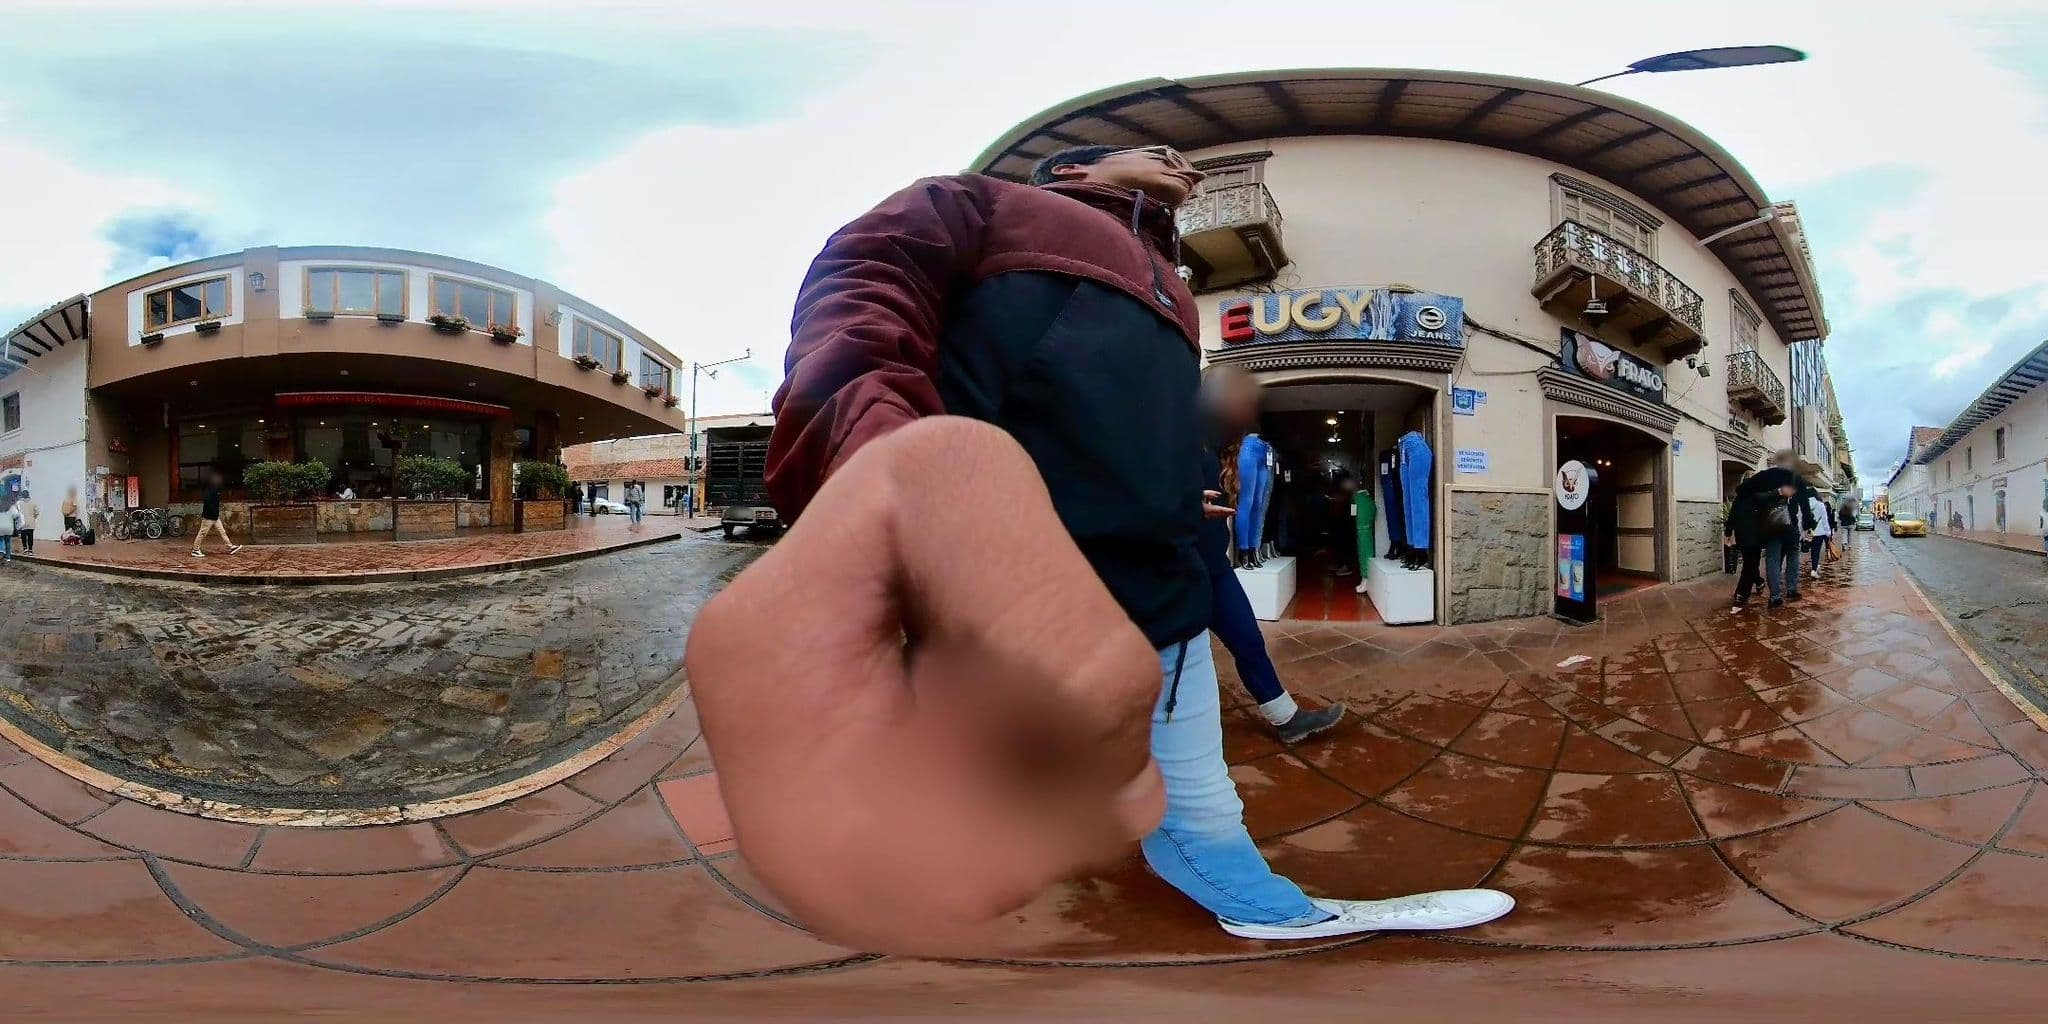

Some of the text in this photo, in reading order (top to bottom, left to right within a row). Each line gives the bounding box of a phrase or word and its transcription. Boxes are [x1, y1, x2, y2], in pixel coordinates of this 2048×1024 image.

[1221, 289, 1375, 342] EUGY
[1410, 330, 1451, 340] JEANS
[1618, 358, 1663, 391] FRATO
